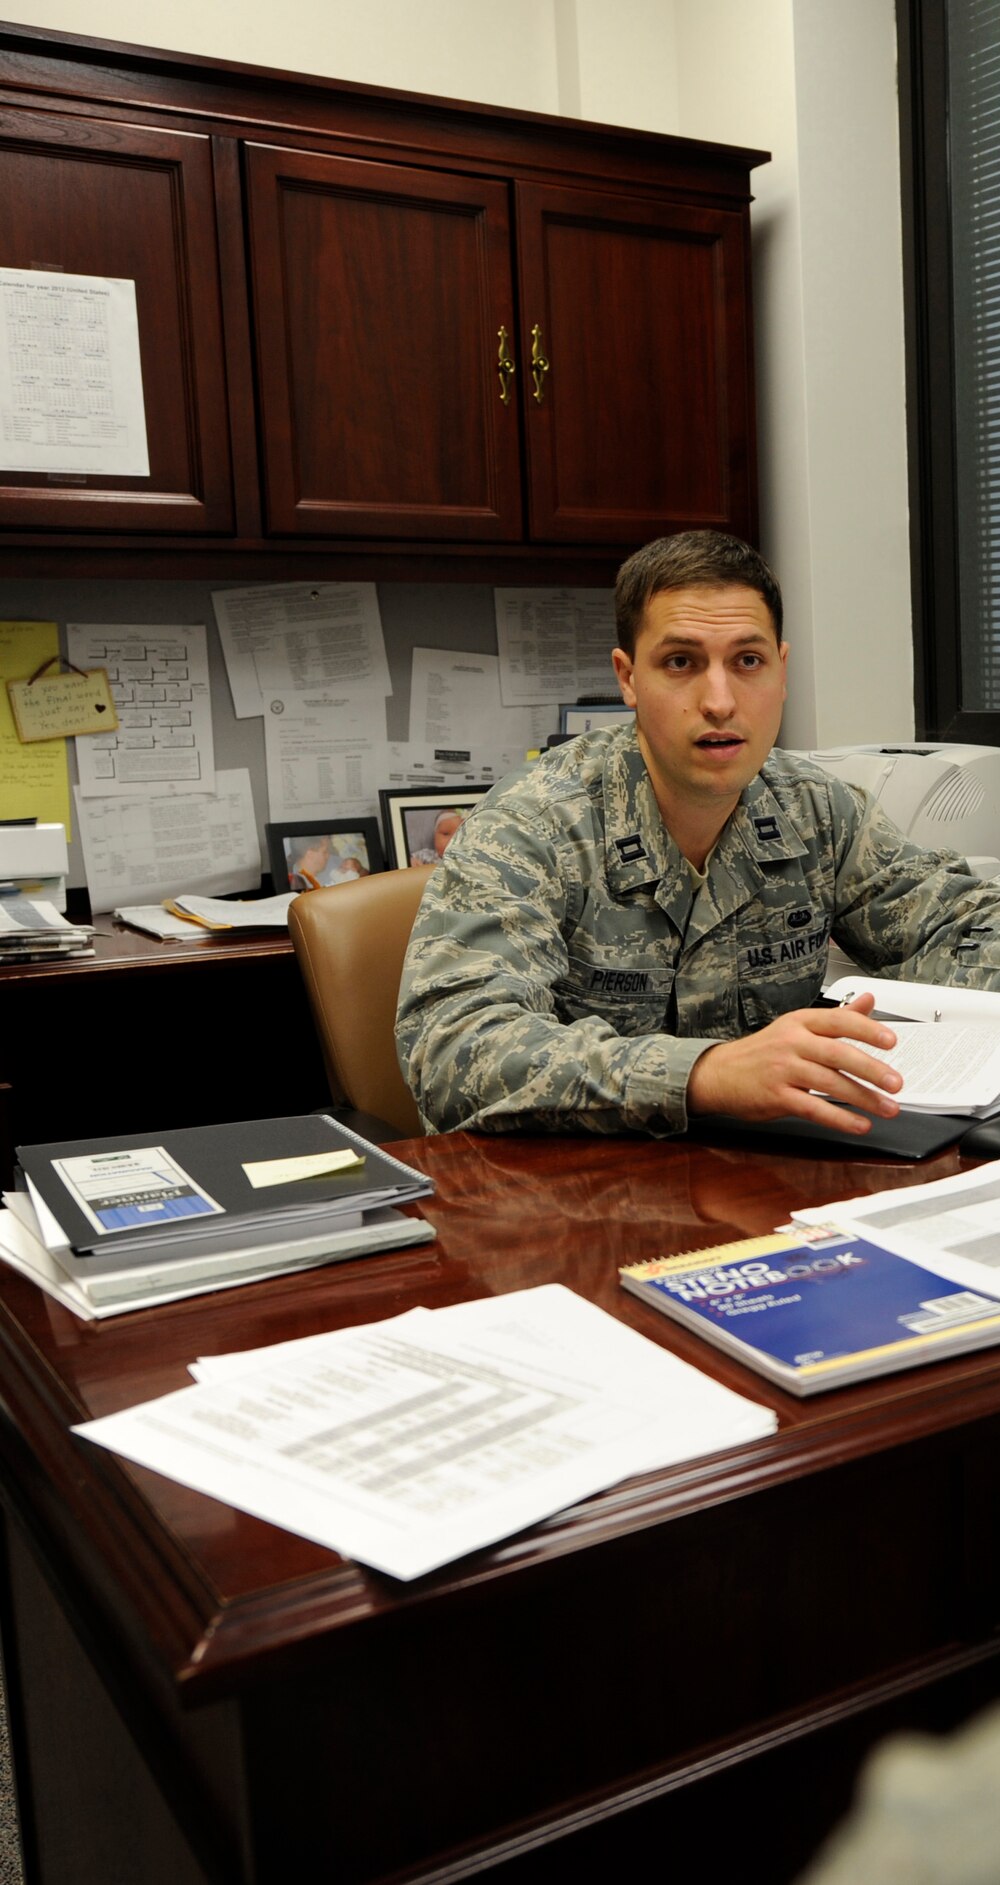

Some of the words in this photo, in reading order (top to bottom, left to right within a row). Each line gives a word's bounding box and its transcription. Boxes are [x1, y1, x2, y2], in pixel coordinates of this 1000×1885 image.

[747, 947, 777, 968] U.S.
[781, 939, 806, 962] AIR
[590, 969, 649, 992] PIERSON
[665, 1262, 770, 1293] STENO
[678, 1251, 864, 1302] NOTEBOOK
